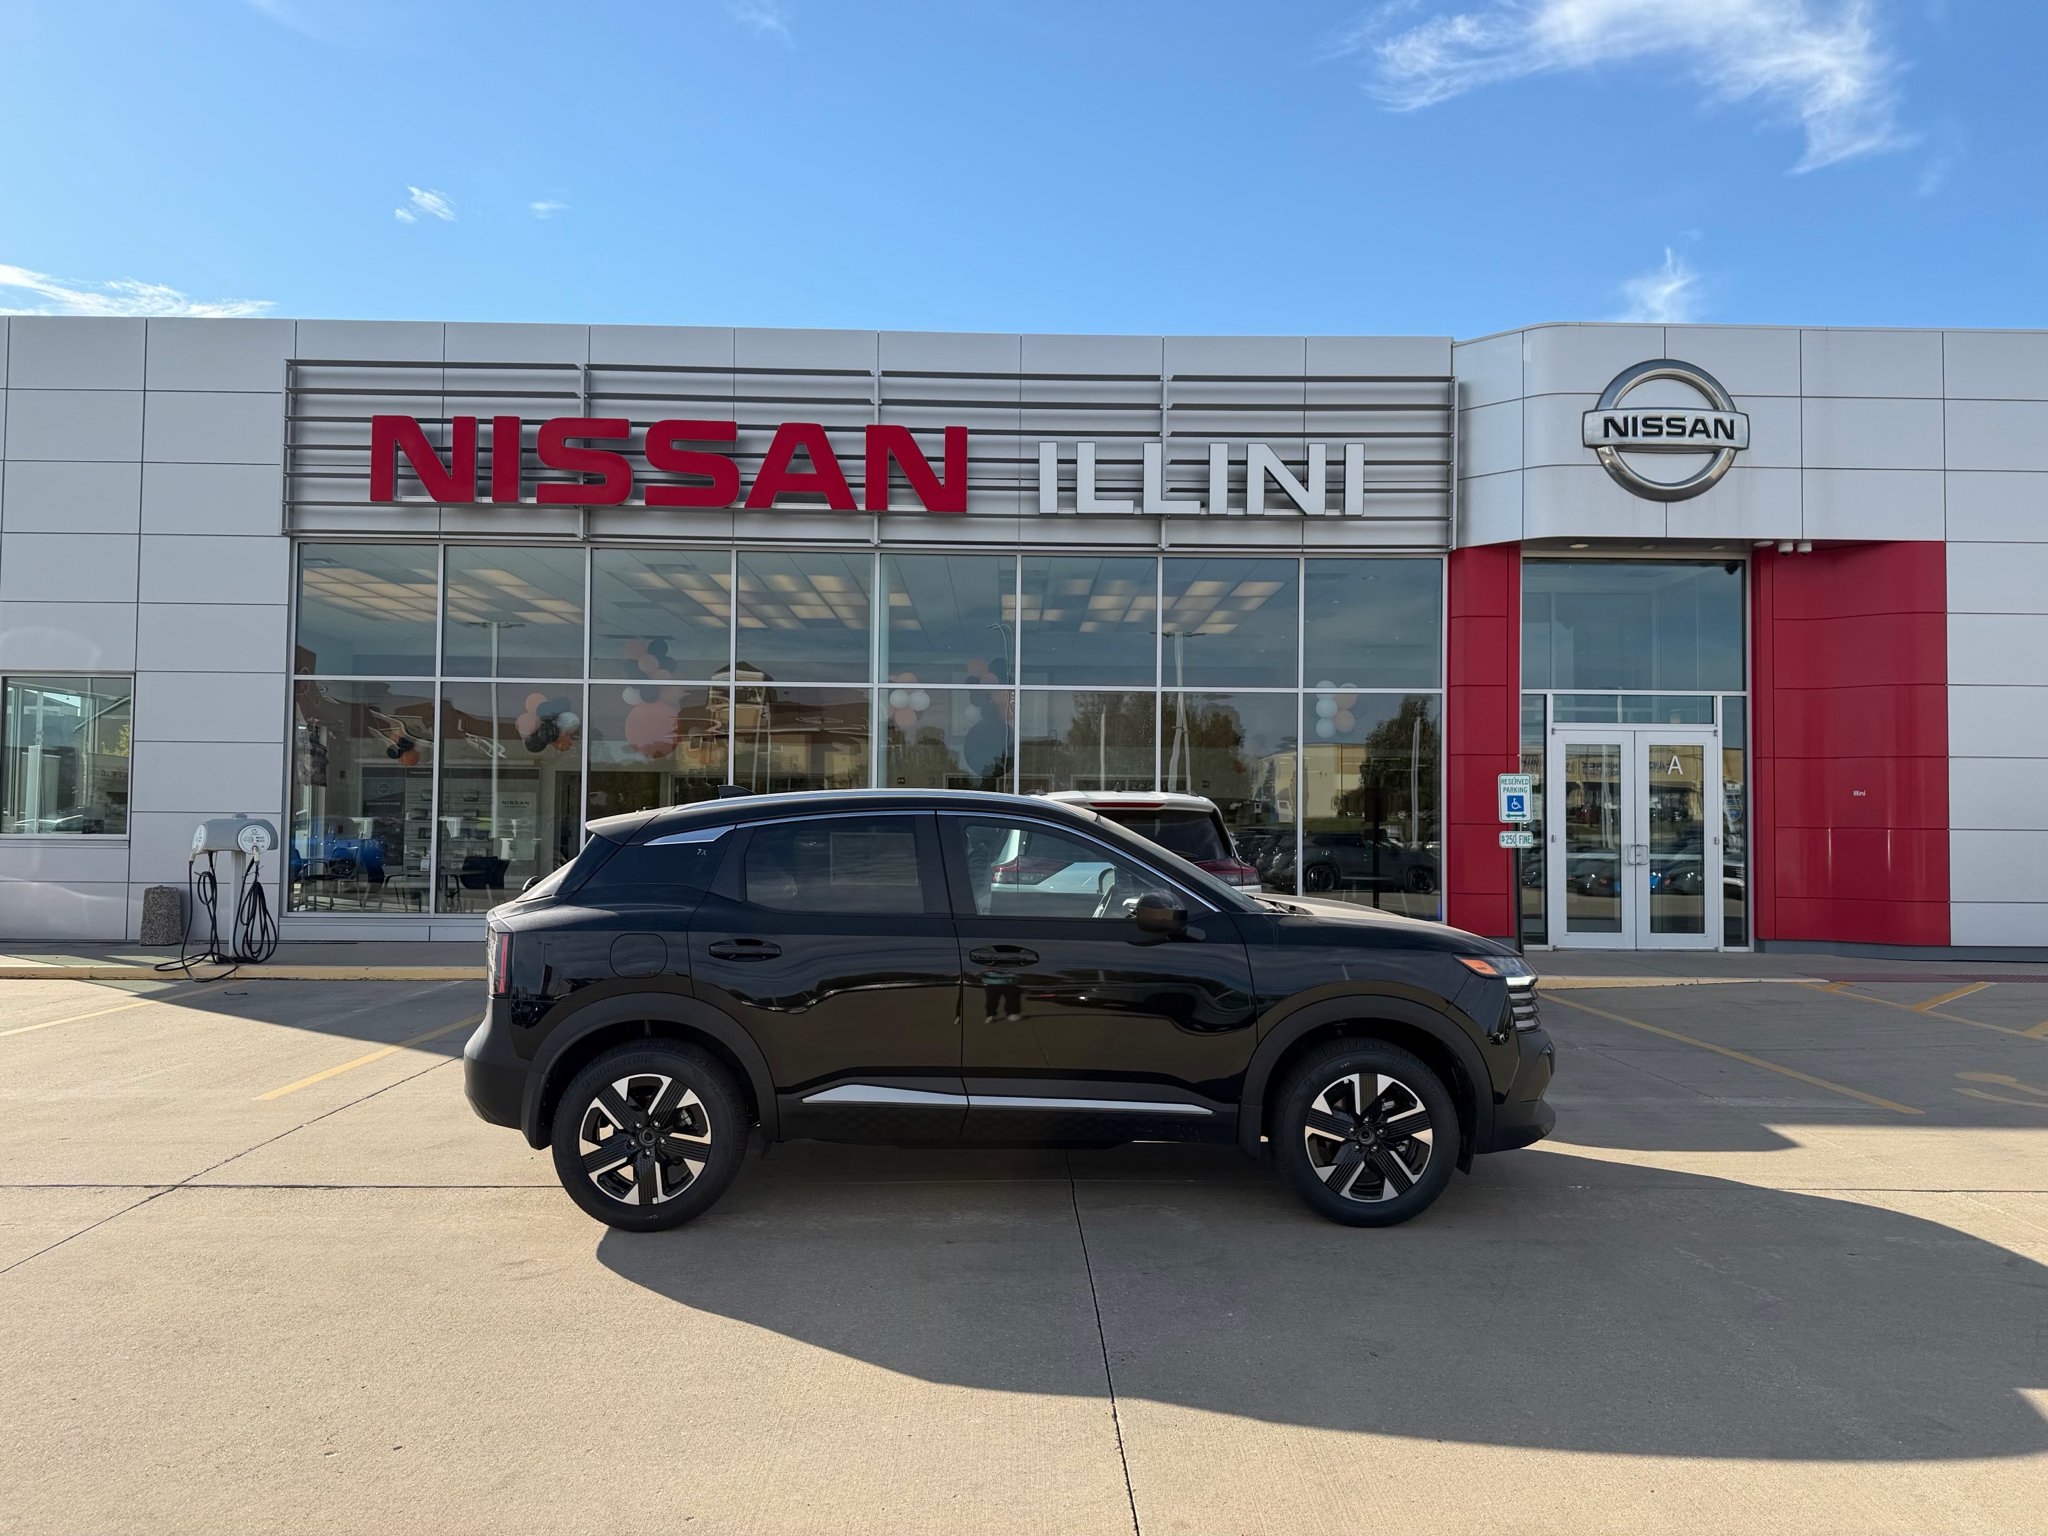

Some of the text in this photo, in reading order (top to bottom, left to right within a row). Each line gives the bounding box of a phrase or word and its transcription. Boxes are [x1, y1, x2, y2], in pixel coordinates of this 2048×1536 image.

[1603, 415, 1736, 441] NISSAN
[370, 415, 1366, 515] NISSAN ILLINI
[1667, 755, 1684, 775] A
[1500, 778, 1529, 786] RESERVED
[1500, 834, 1532, 845] $250 FINE
